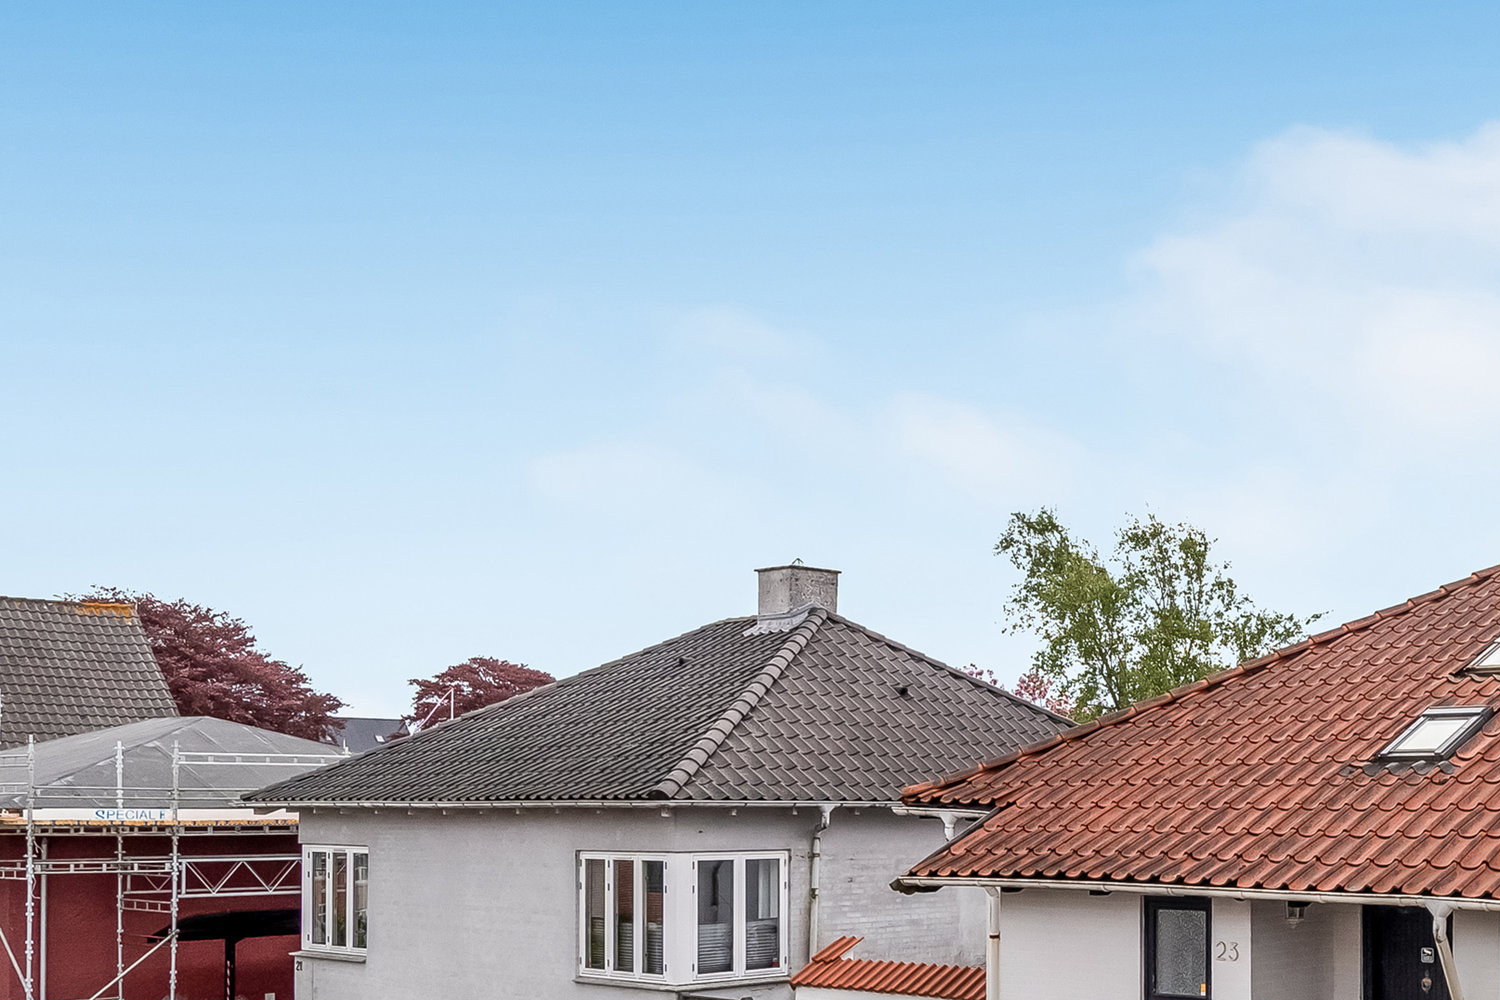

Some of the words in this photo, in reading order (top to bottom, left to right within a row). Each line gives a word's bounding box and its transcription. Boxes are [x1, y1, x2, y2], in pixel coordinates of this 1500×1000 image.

[95, 810, 156, 820] SPECIAL
[1216, 941, 1240, 961] 23
[295, 960, 303, 971] 21
